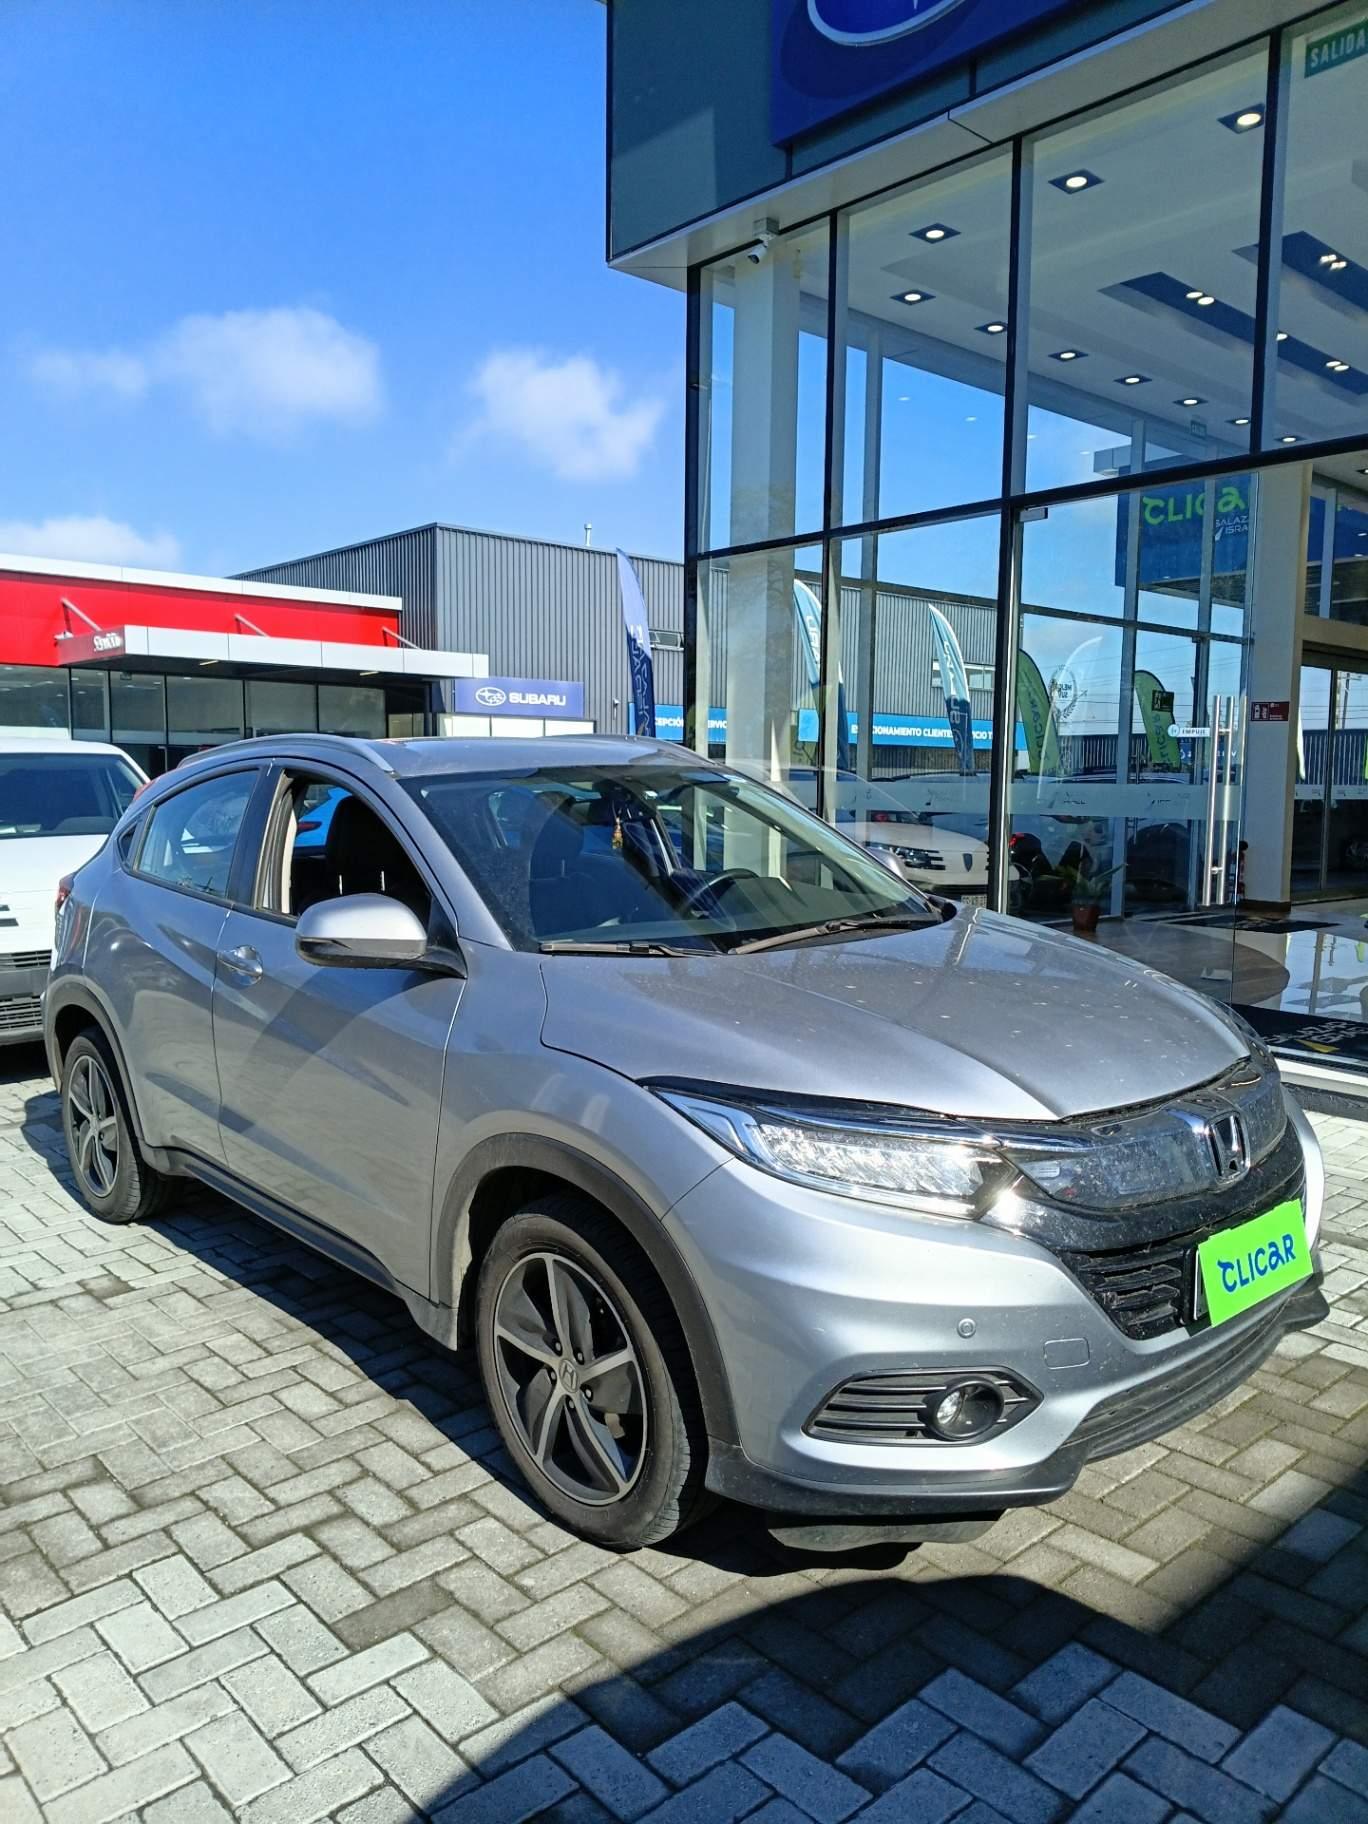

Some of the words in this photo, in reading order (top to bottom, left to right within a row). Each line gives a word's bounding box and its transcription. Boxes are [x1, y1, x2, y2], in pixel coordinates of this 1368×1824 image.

[1311, 28, 1365, 67] SALIDA
[509, 692, 566, 706] SUBARU
[655, 714, 683, 728] CEPCIÓ
[707, 719, 727, 729] ERVIC
